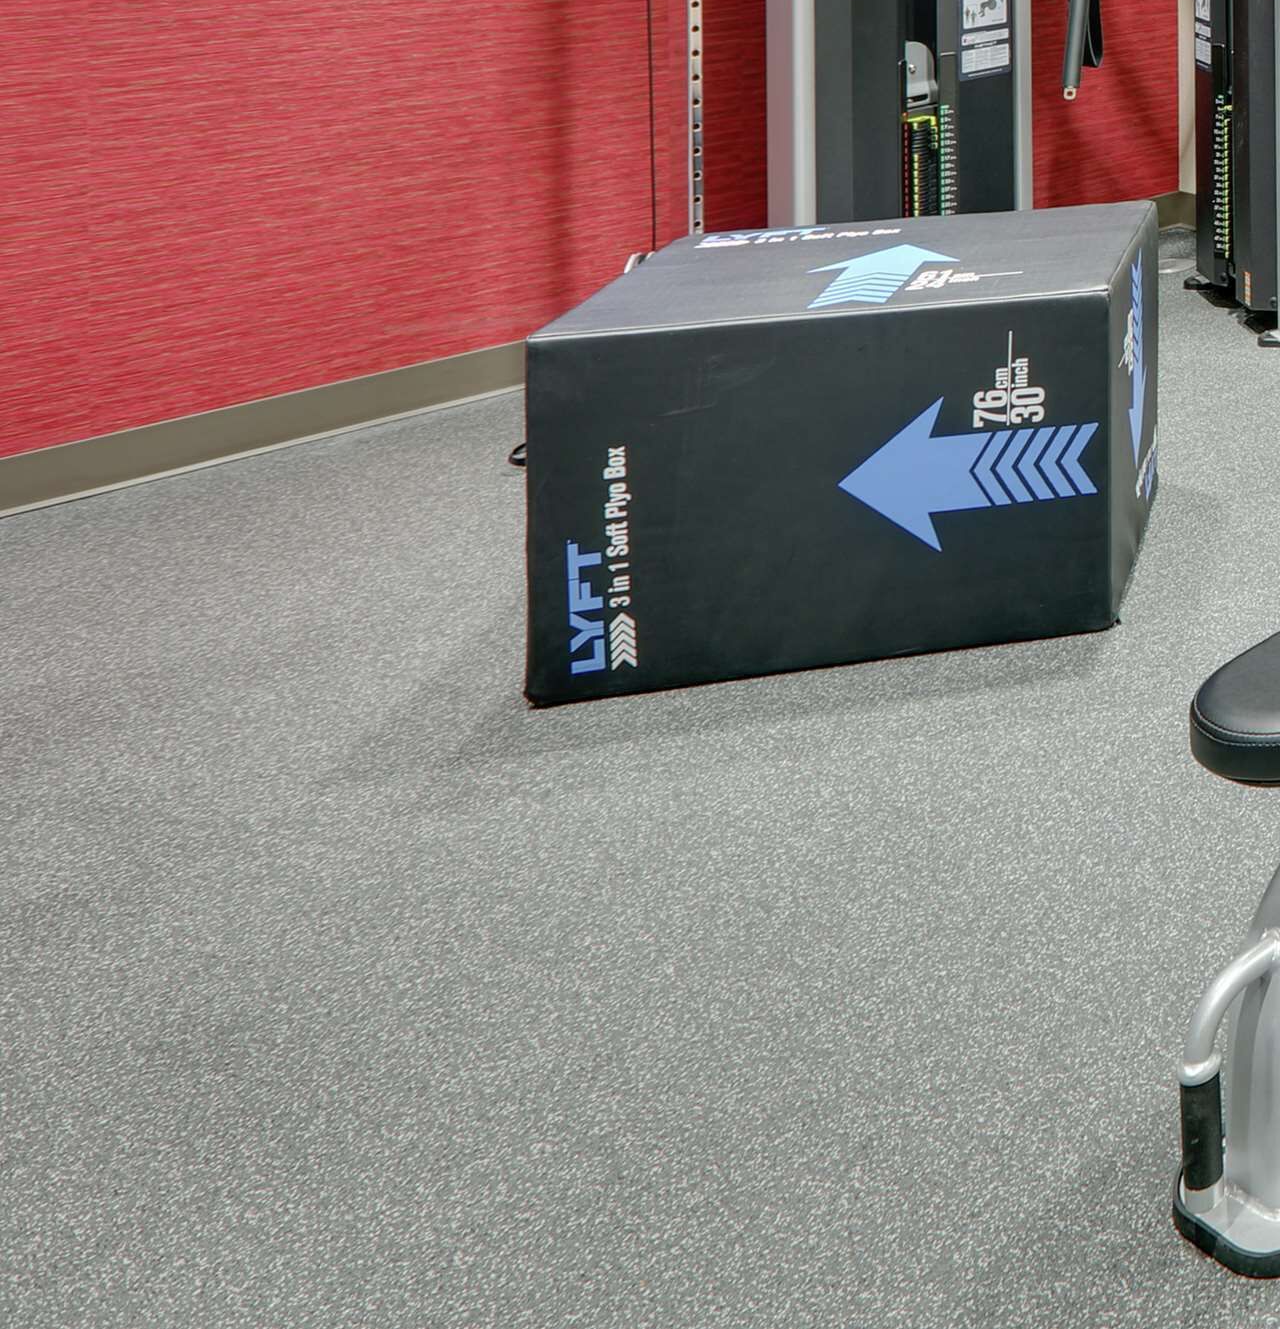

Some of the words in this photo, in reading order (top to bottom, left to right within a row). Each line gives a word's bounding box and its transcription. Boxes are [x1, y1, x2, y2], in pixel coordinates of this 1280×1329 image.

[603, 446, 626, 480] Box
[604, 482, 632, 519] Plyo
[606, 521, 629, 557] Soft
[608, 562, 629, 572] 1
[608, 575, 630, 593] in
[567, 543, 605, 674] LYFT
[609, 596, 631, 608] 3
